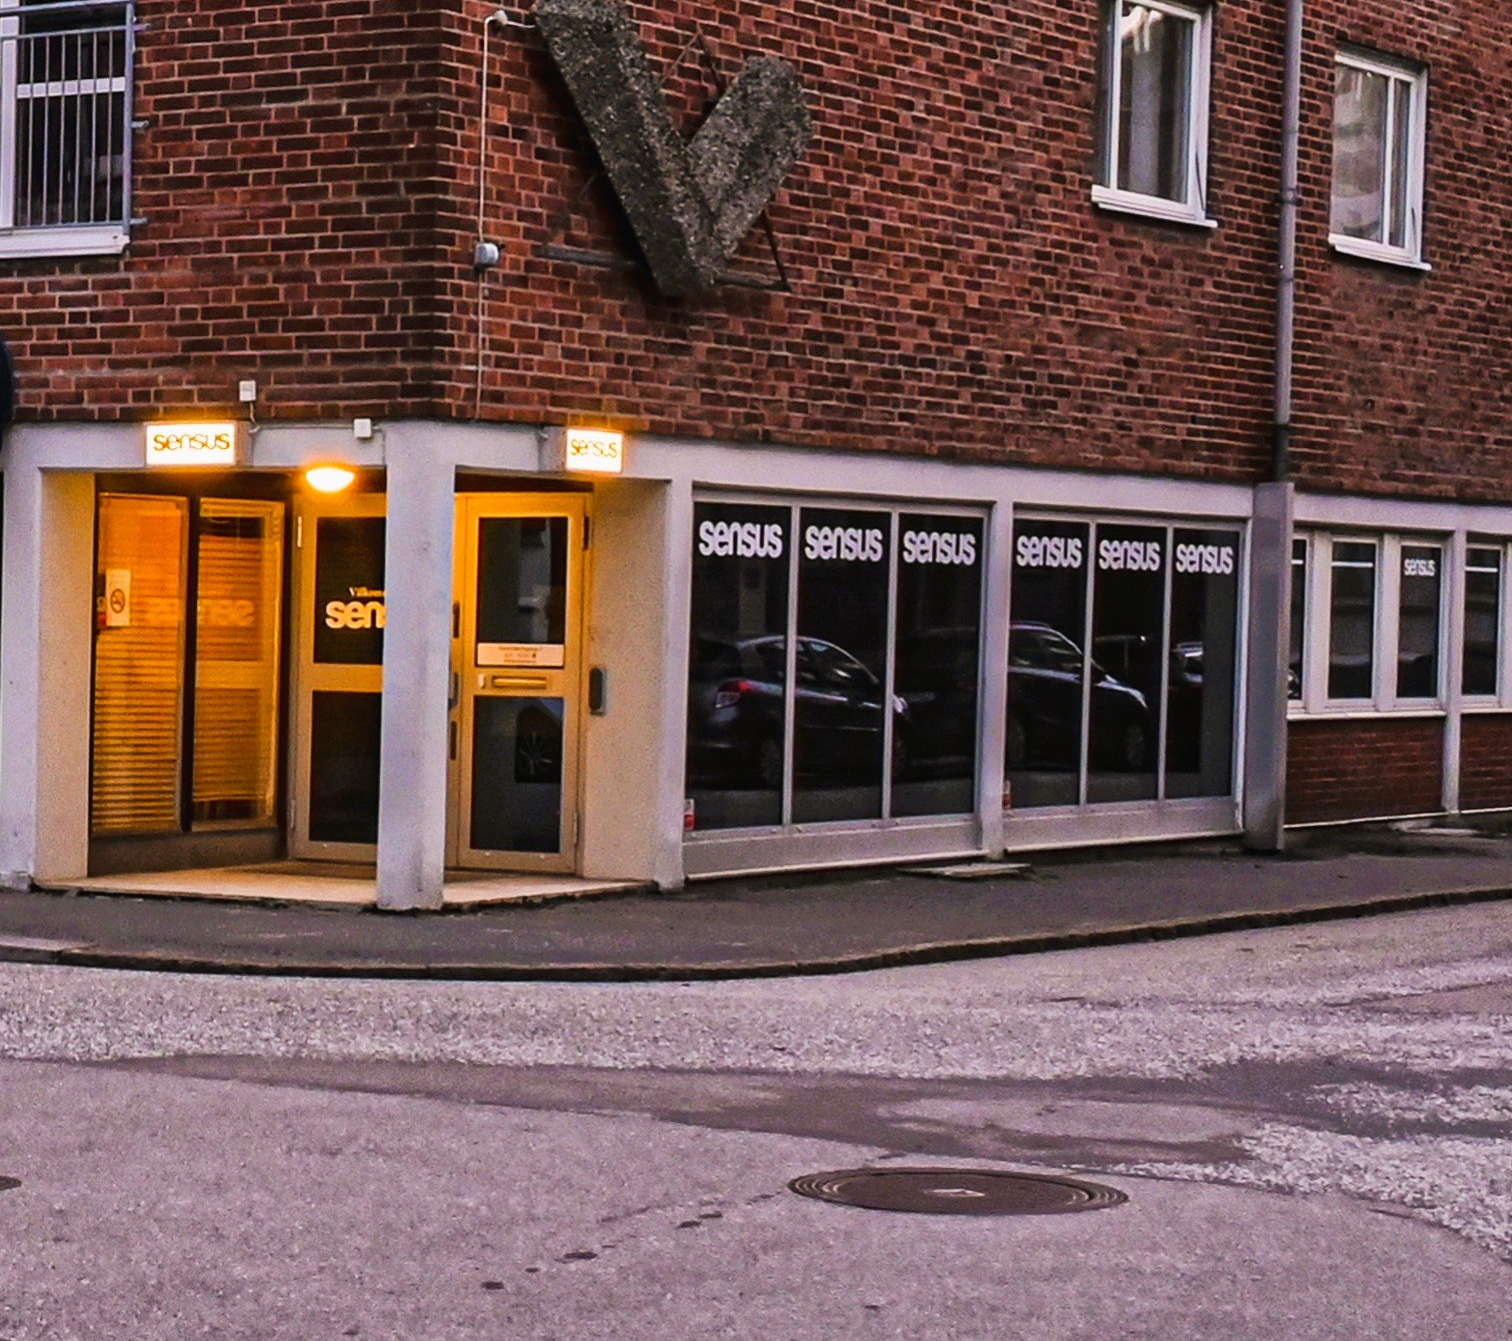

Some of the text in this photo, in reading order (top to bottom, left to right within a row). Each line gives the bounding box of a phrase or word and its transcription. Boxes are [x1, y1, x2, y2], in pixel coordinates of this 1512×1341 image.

[153, 433, 231, 451] sensus
[698, 520, 783, 559] sensus
[805, 525, 883, 562] sensus
[902, 530, 976, 566] sensus
[1016, 535, 1082, 569] sensus
[1098, 539, 1161, 572] sensus
[1176, 543, 1234, 575] sensus
[325, 601, 387, 629] sen
